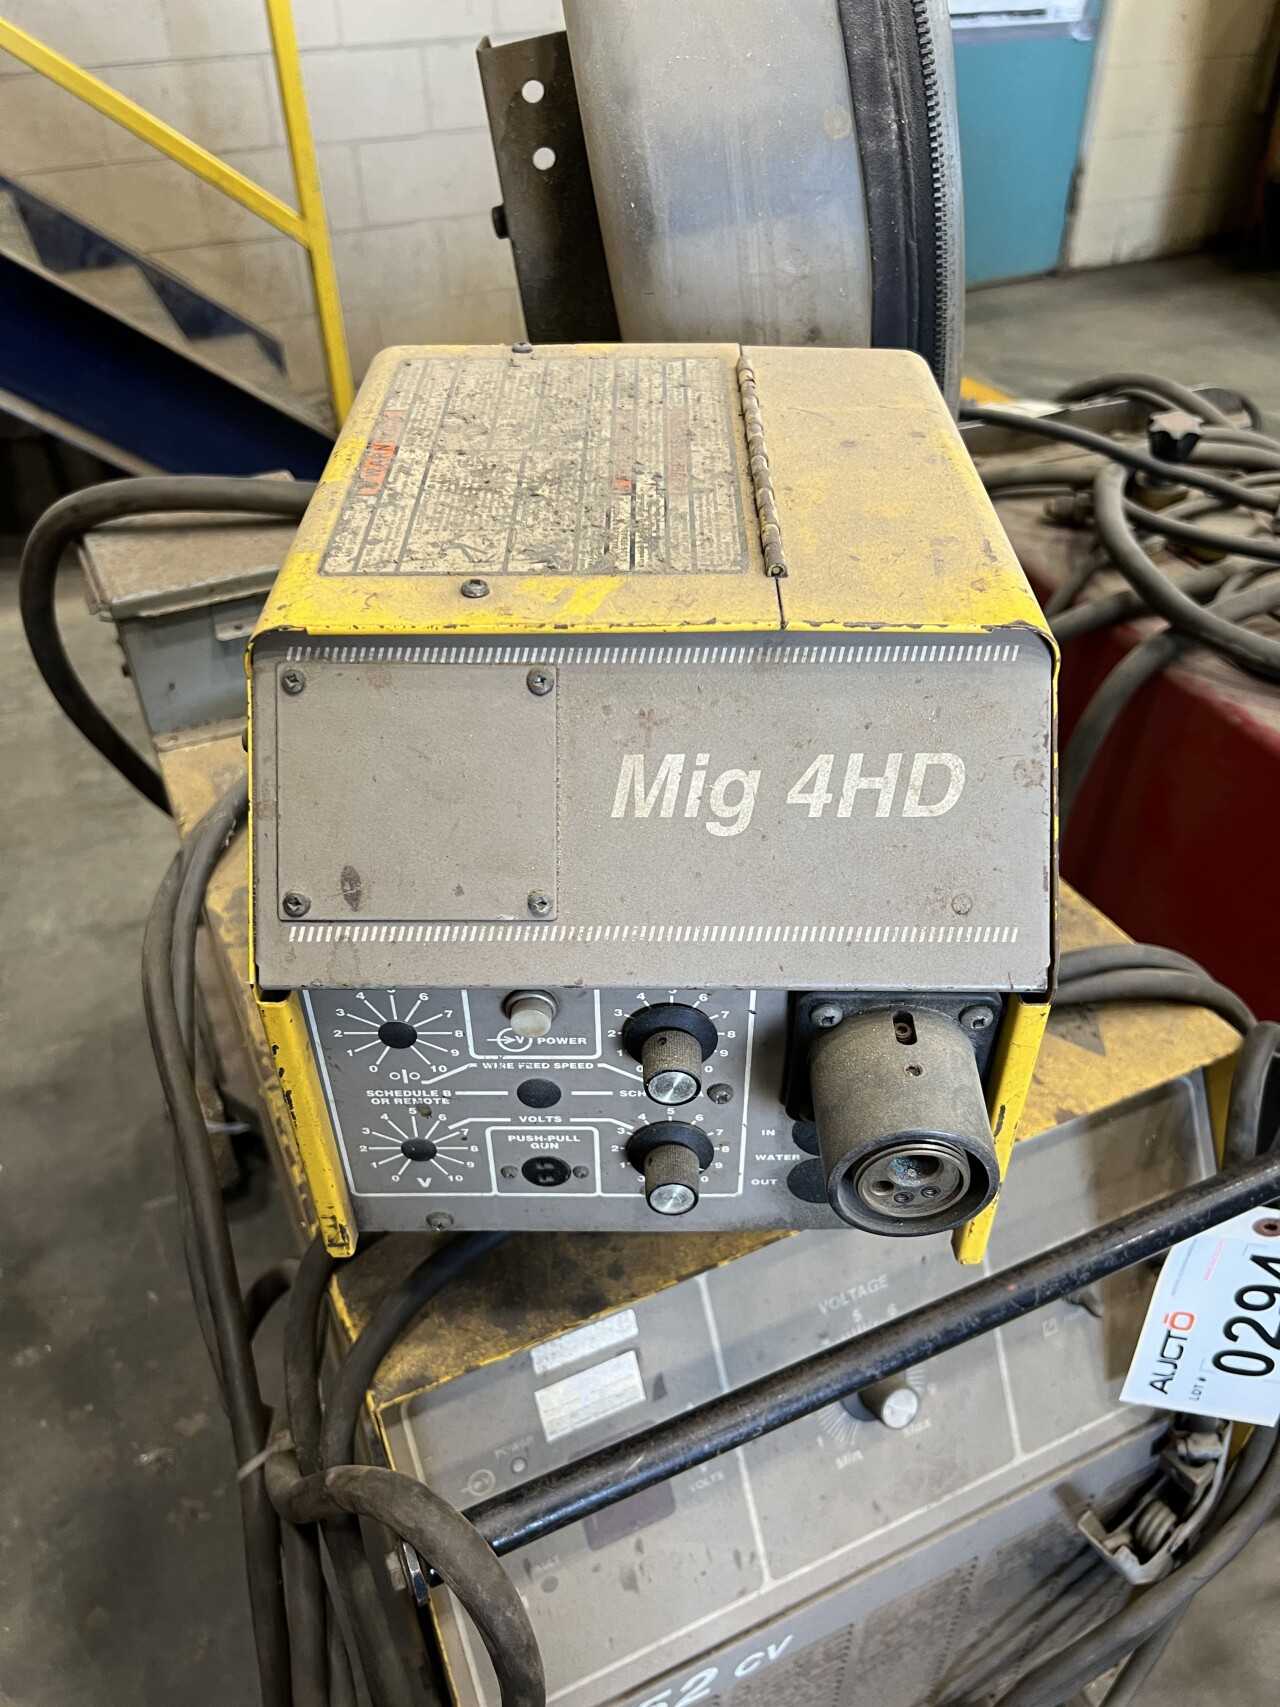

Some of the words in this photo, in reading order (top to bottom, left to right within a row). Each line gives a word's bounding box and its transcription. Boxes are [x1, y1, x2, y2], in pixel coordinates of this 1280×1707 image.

[610, 753, 762, 837] Mig
[785, 752, 966, 818] 4HD
[356, 992, 365, 1000] 4
[419, 992, 429, 1001] 6
[636, 992, 645, 1000] 4
[698, 993, 708, 1001] 6
[335, 1008, 346, 1017] 3
[444, 1010, 453, 1018] 7
[614, 1008, 623, 1017] 3
[720, 1011, 730, 1019] 7
[333, 1029, 343, 1038] 2
[454, 1029, 464, 1038] 8
[607, 1030, 617, 1038] 2
[727, 1030, 736, 1038] 8
[537, 1037, 588, 1045] POWER
[346, 1049, 353, 1057] 1
[450, 1049, 460, 1057] 9
[616, 1049, 623, 1057] 1
[719, 1049, 729, 1057] 9
[431, 1065, 447, 1073] 10
[408, 1107, 417, 1115] 5
[667, 1107, 676, 1115] 5
[519, 1115, 562, 1123] VOLTS
[362, 1127, 371, 1135] 3
[460, 1128, 469, 1136] 7
[530, 1142, 560, 1150] GUN
[755, 1153, 800, 1161] WATER
[417, 1177, 432, 1188] V
[751, 1178, 778, 1186] OUT
[817, 1274, 889, 1315] VOLTAGE
